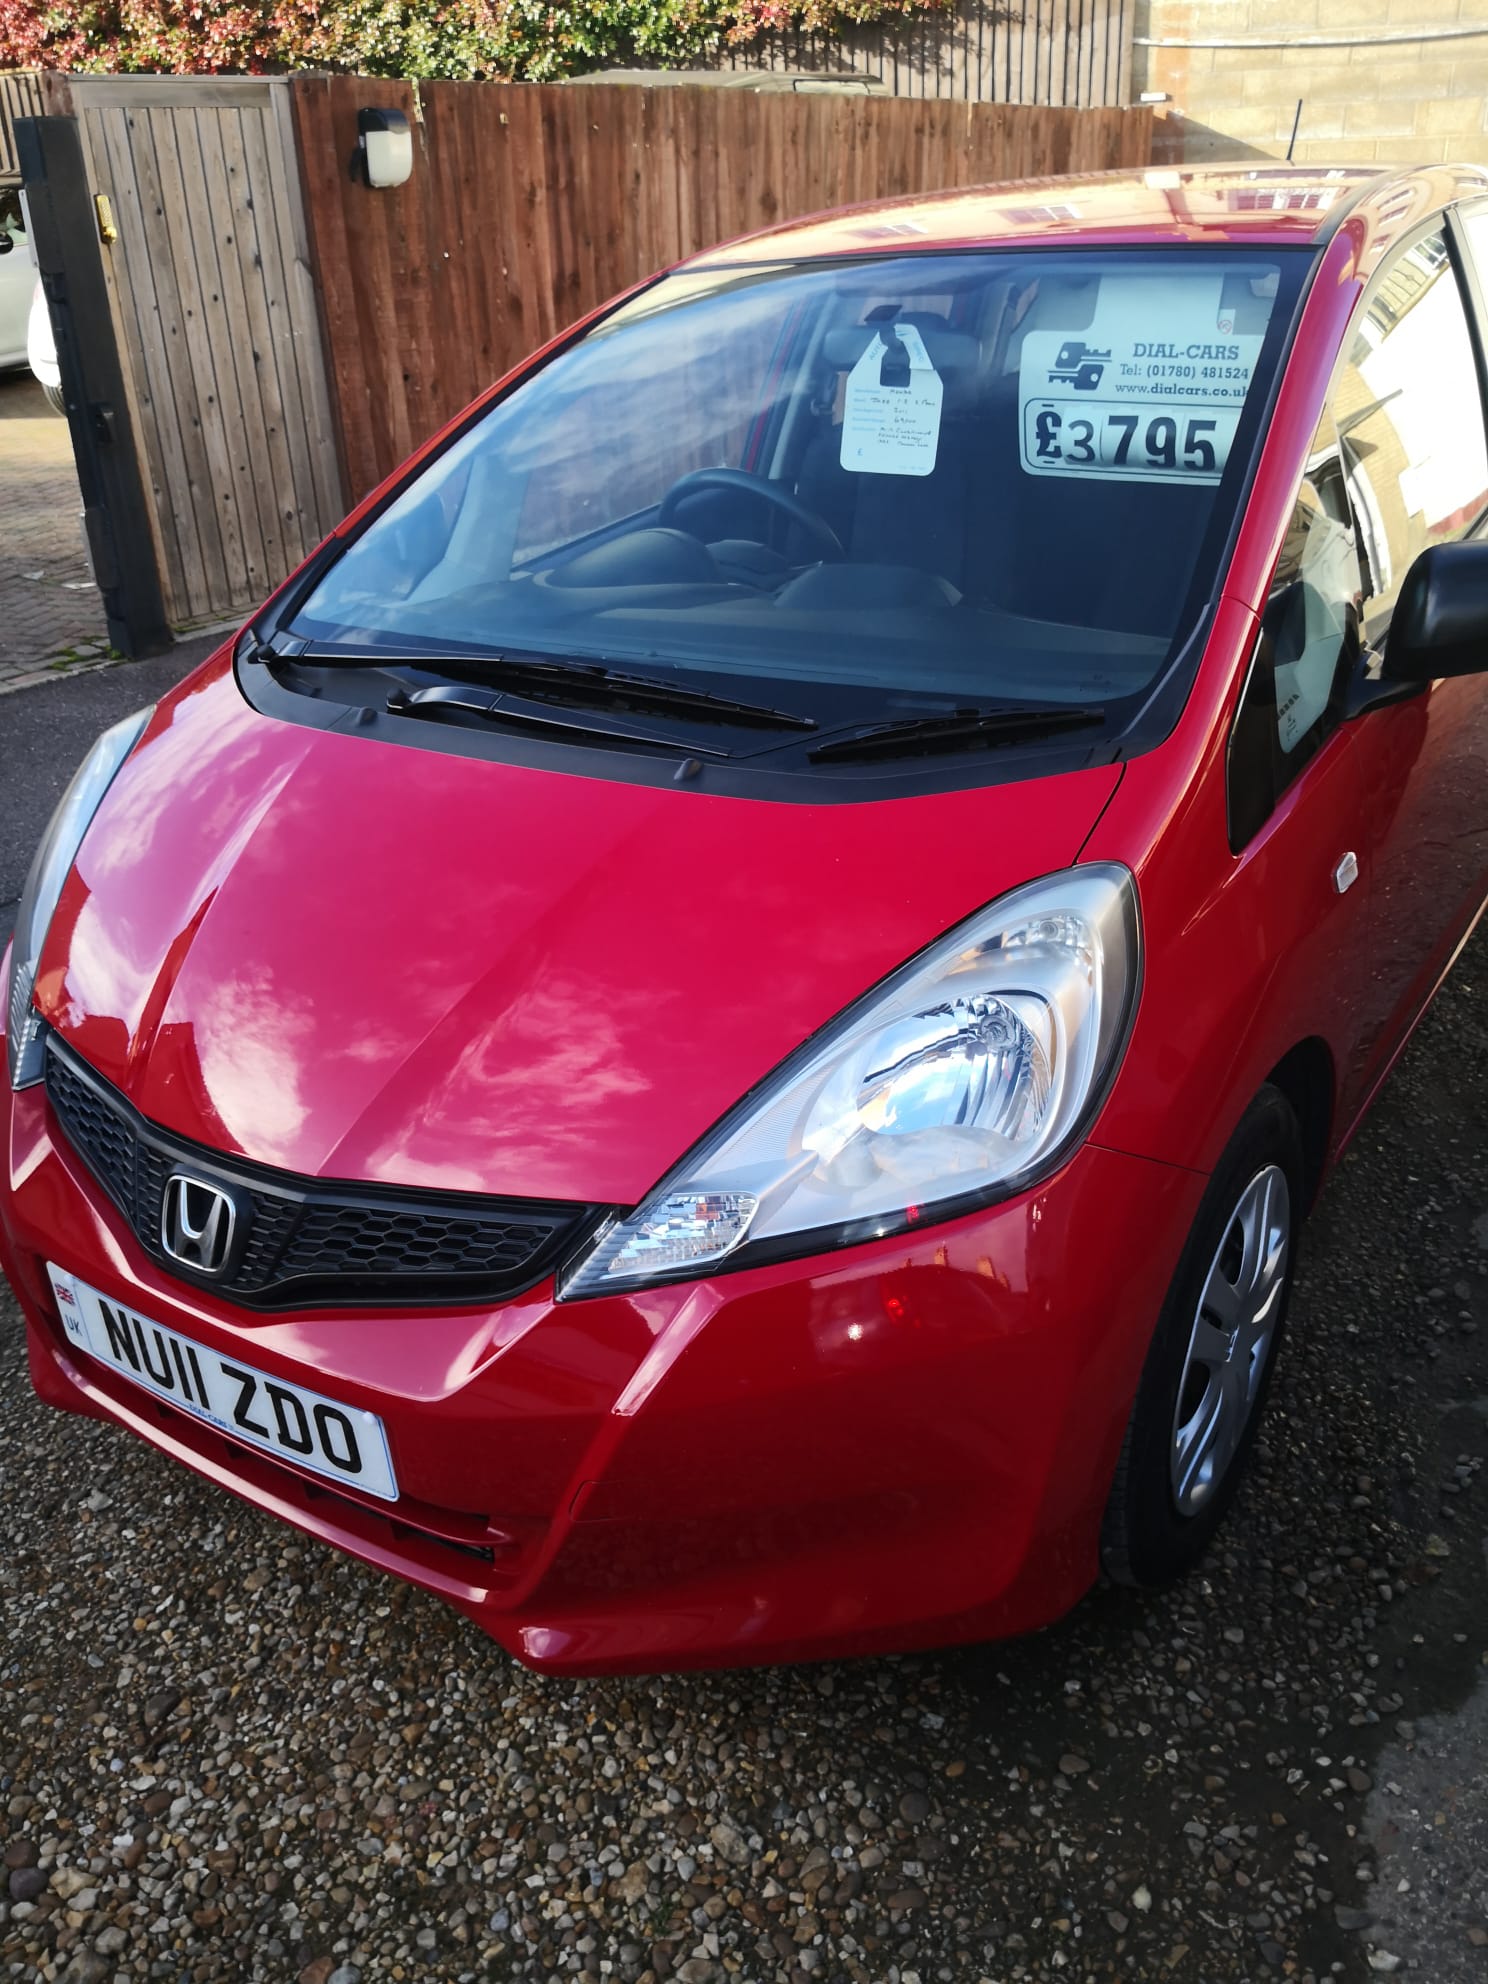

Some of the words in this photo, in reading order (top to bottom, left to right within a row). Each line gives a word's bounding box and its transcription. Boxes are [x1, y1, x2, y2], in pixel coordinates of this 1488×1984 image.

[1132, 343, 1240, 360] DIAL-CARS
[1120, 363, 1142, 376] Tel:
[1146, 364, 1196, 379] (01780)
[1201, 366, 1249, 379] 481524
[65, 1314, 83, 1337] UK
[98, 1298, 211, 1411] NU11
[220, 1361, 362, 1474] ZDO
